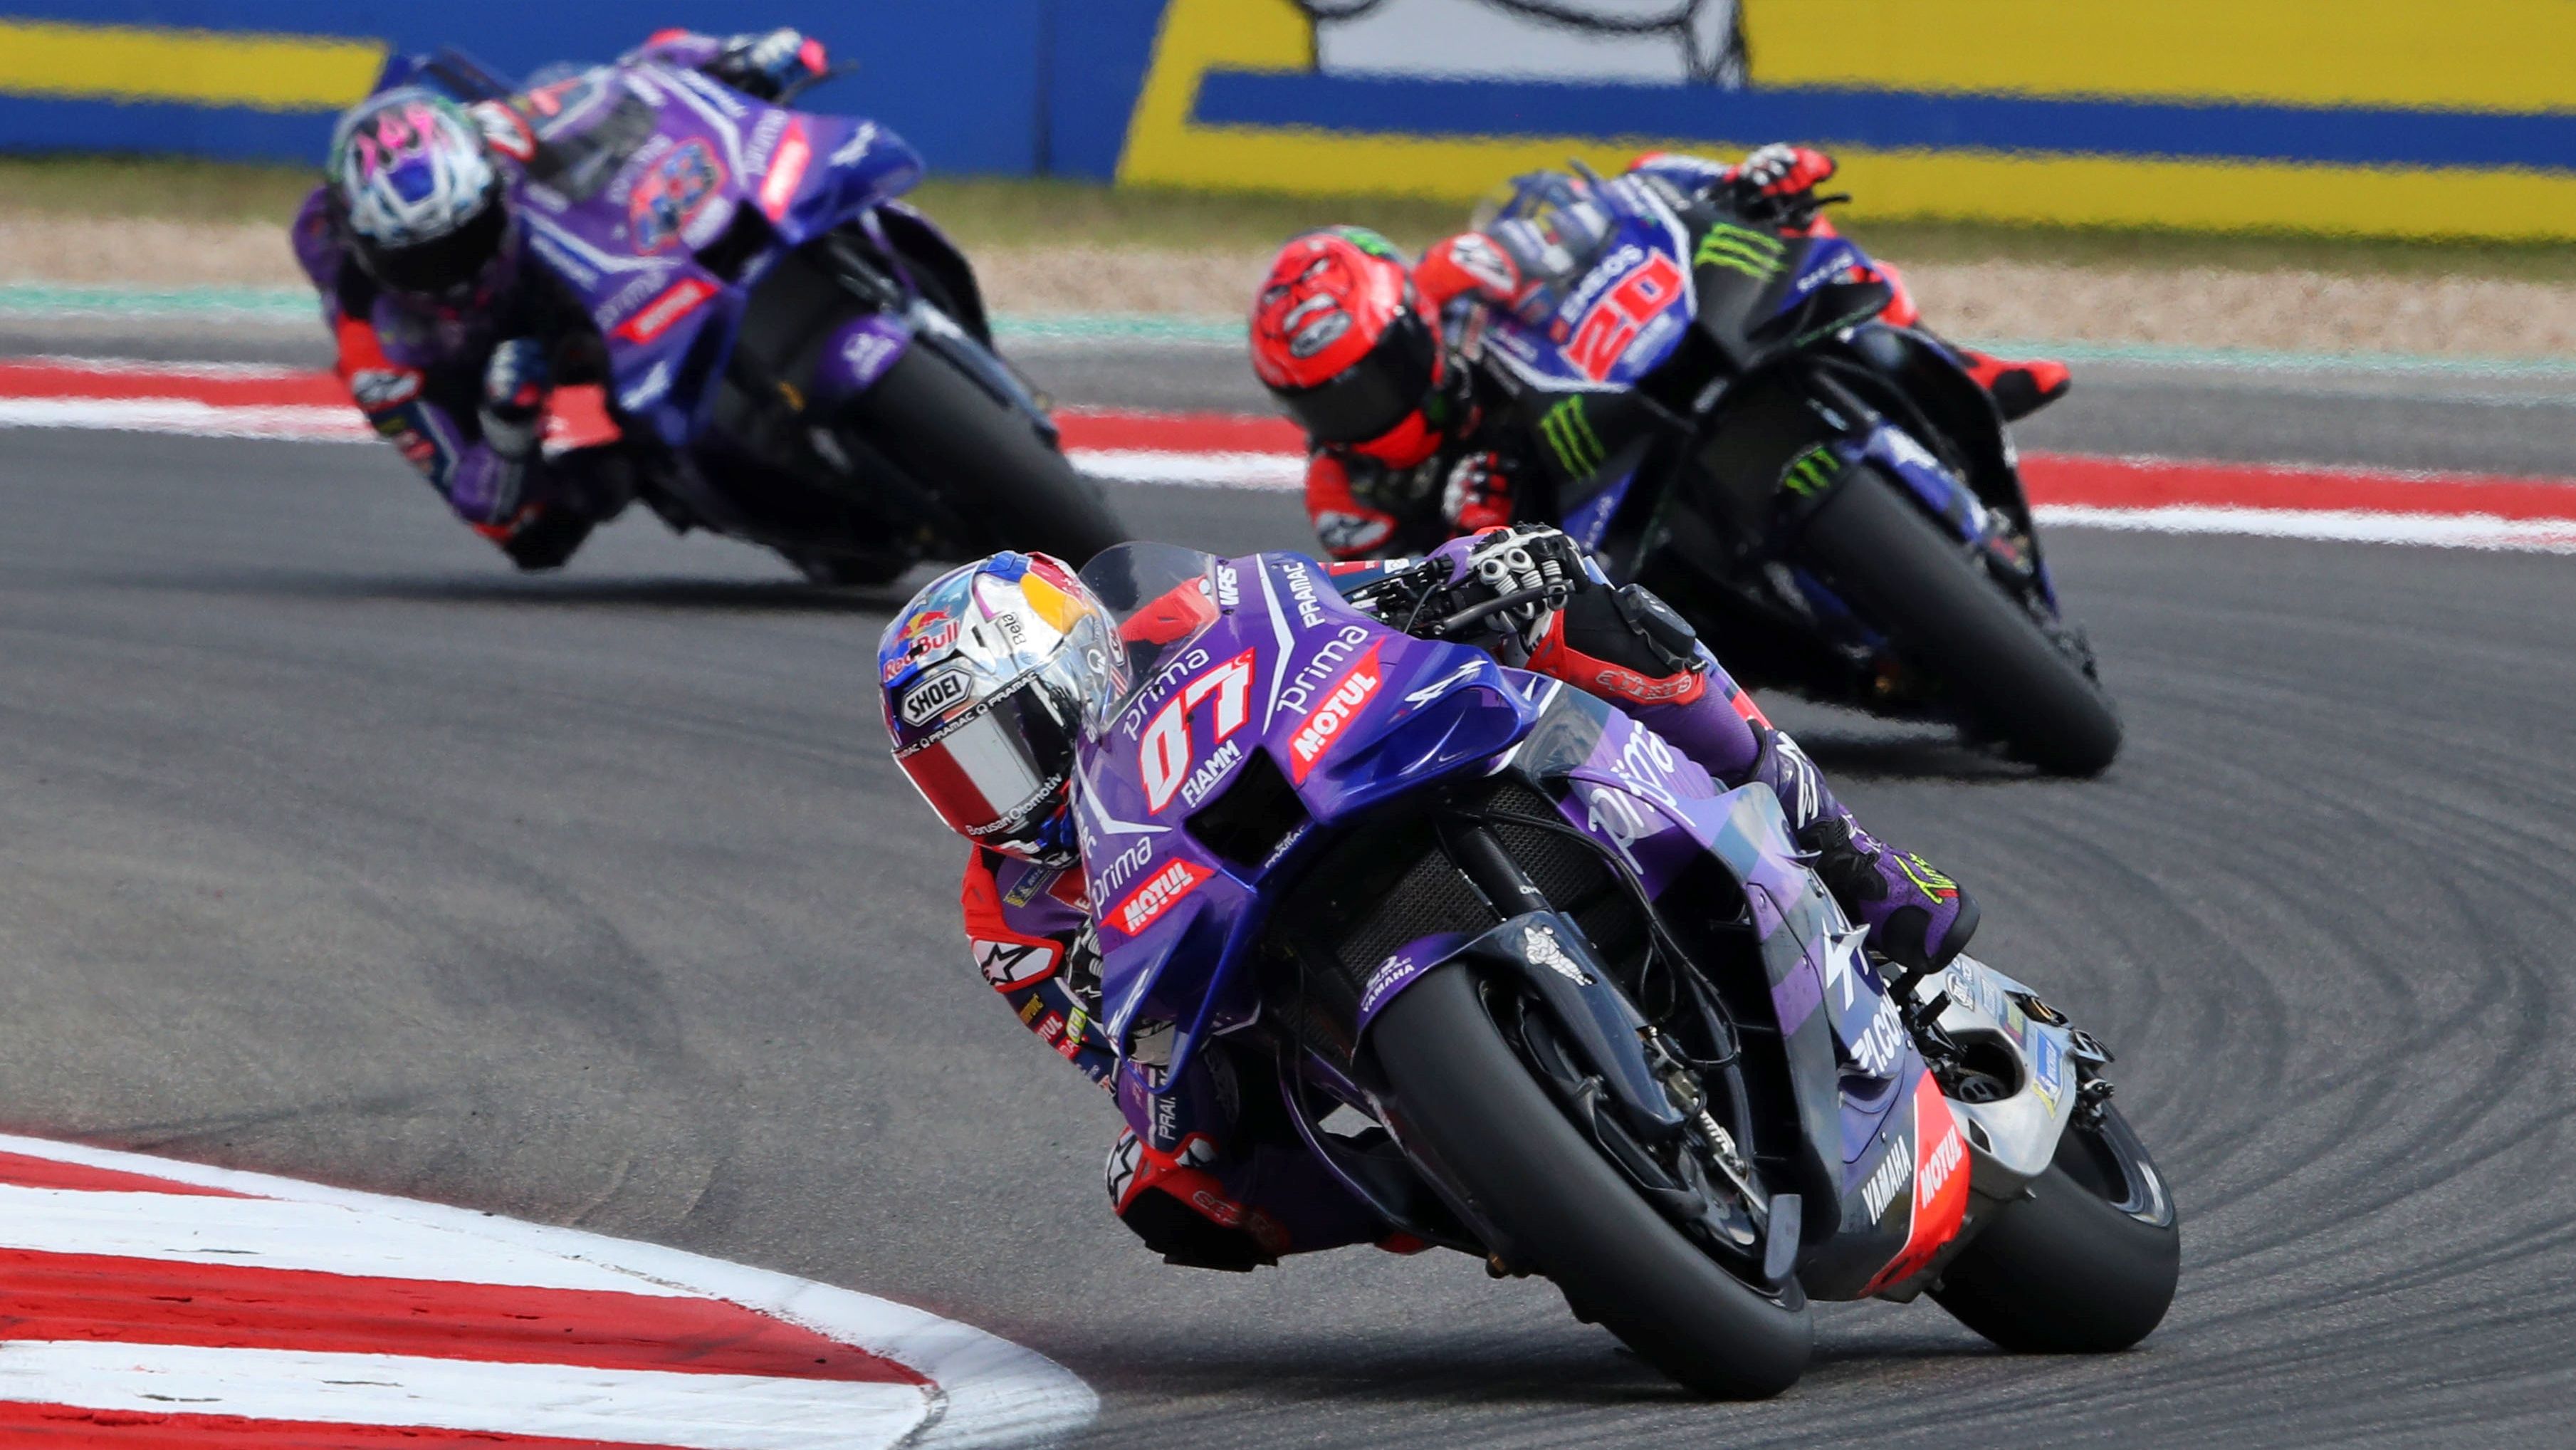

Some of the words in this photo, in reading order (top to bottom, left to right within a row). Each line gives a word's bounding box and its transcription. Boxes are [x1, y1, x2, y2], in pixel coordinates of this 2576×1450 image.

[1556, 248, 1684, 383] 20
[1217, 565, 1240, 605] WRS
[1283, 561, 1326, 628] PRAMAC
[884, 650, 916, 682] Red
[920, 622, 960, 654] Bull
[1276, 626, 1369, 714] prima
[908, 675, 962, 719] SHOEI
[1122, 649, 1210, 741] prima
[1138, 648, 1255, 815] 07
[1293, 672, 1377, 762] MOTUL
[965, 813, 1012, 835] Borusan
[1008, 773, 1062, 820] Otomotiv
[1180, 739, 1242, 806] FIAMM
[1091, 836, 1152, 919] prima
[1124, 862, 1194, 933] MOTUL
[1363, 964, 1415, 1012] YAMAHA
[1861, 1135, 1912, 1226] YAMAHA
[1920, 1125, 1962, 1209] MOTUL
